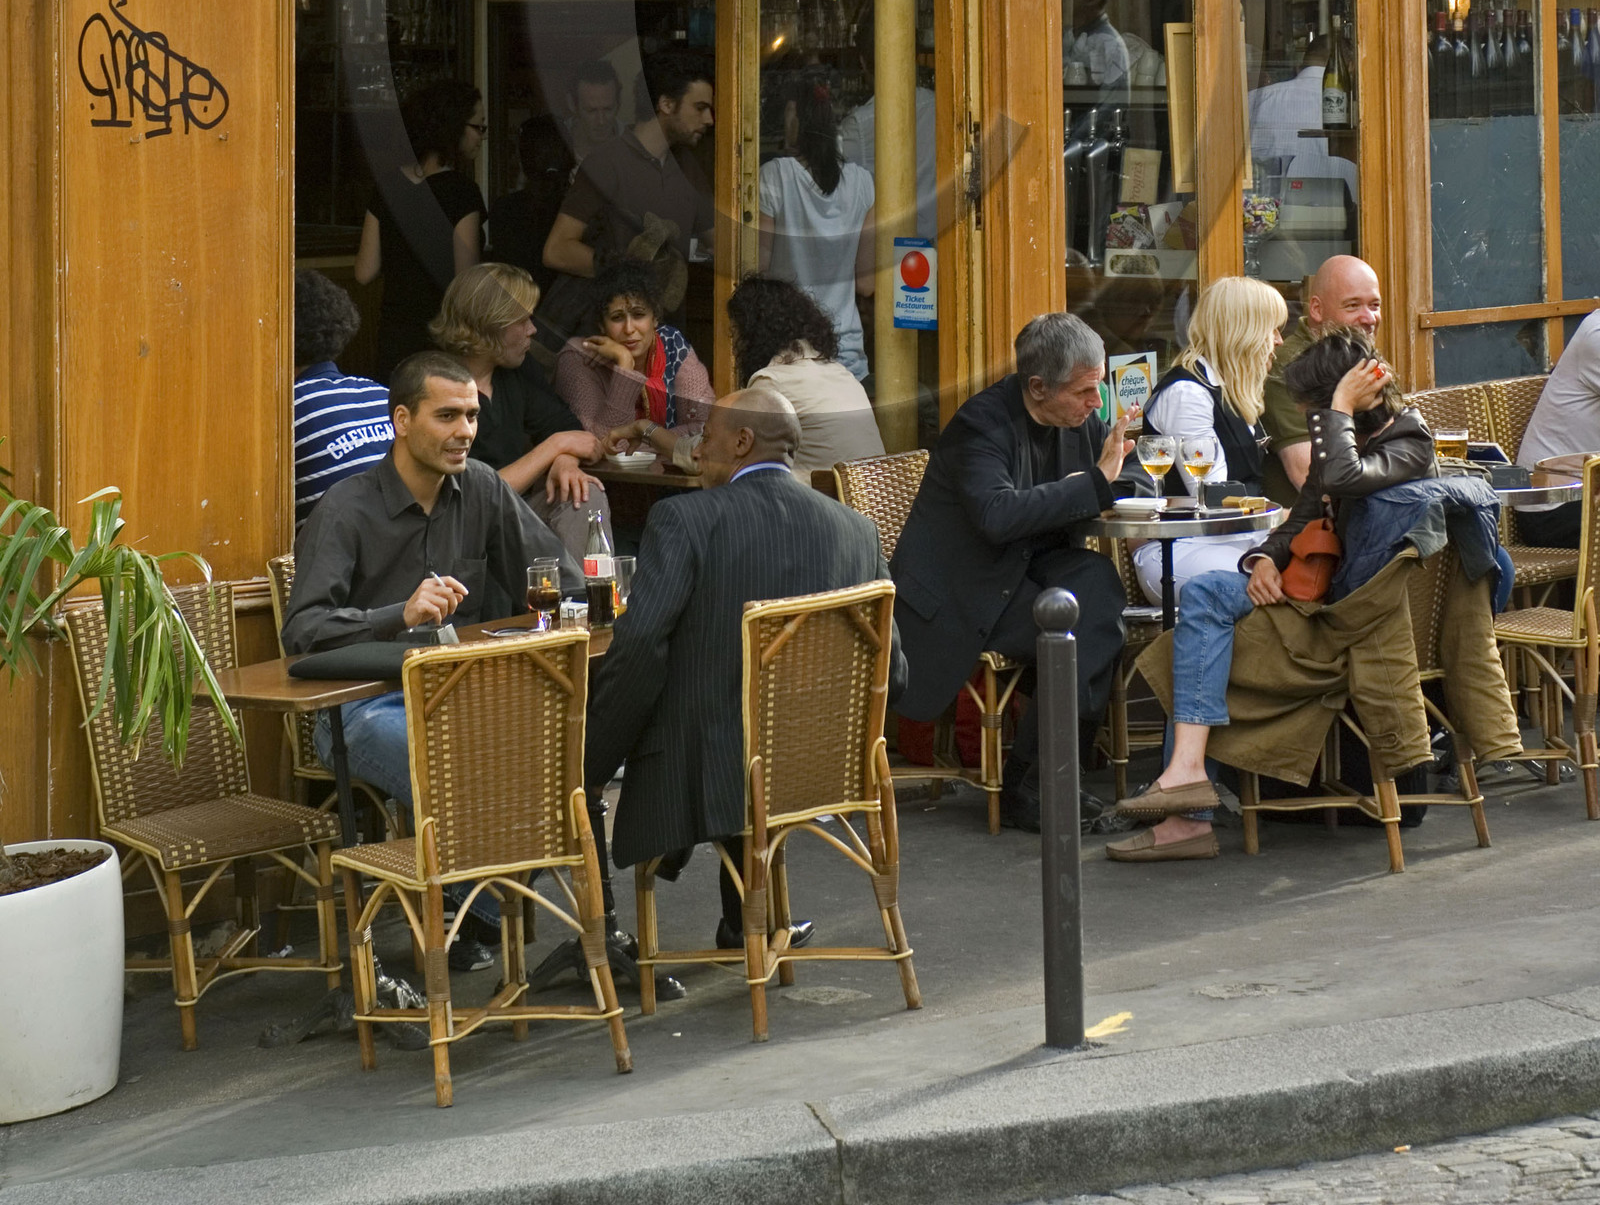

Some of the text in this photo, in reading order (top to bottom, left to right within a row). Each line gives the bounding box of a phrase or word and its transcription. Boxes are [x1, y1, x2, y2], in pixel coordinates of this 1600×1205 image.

[904, 294, 926, 304] Ticket
[895, 301, 935, 311] Restaurant
[1119, 385, 1148, 398] déjeuner
